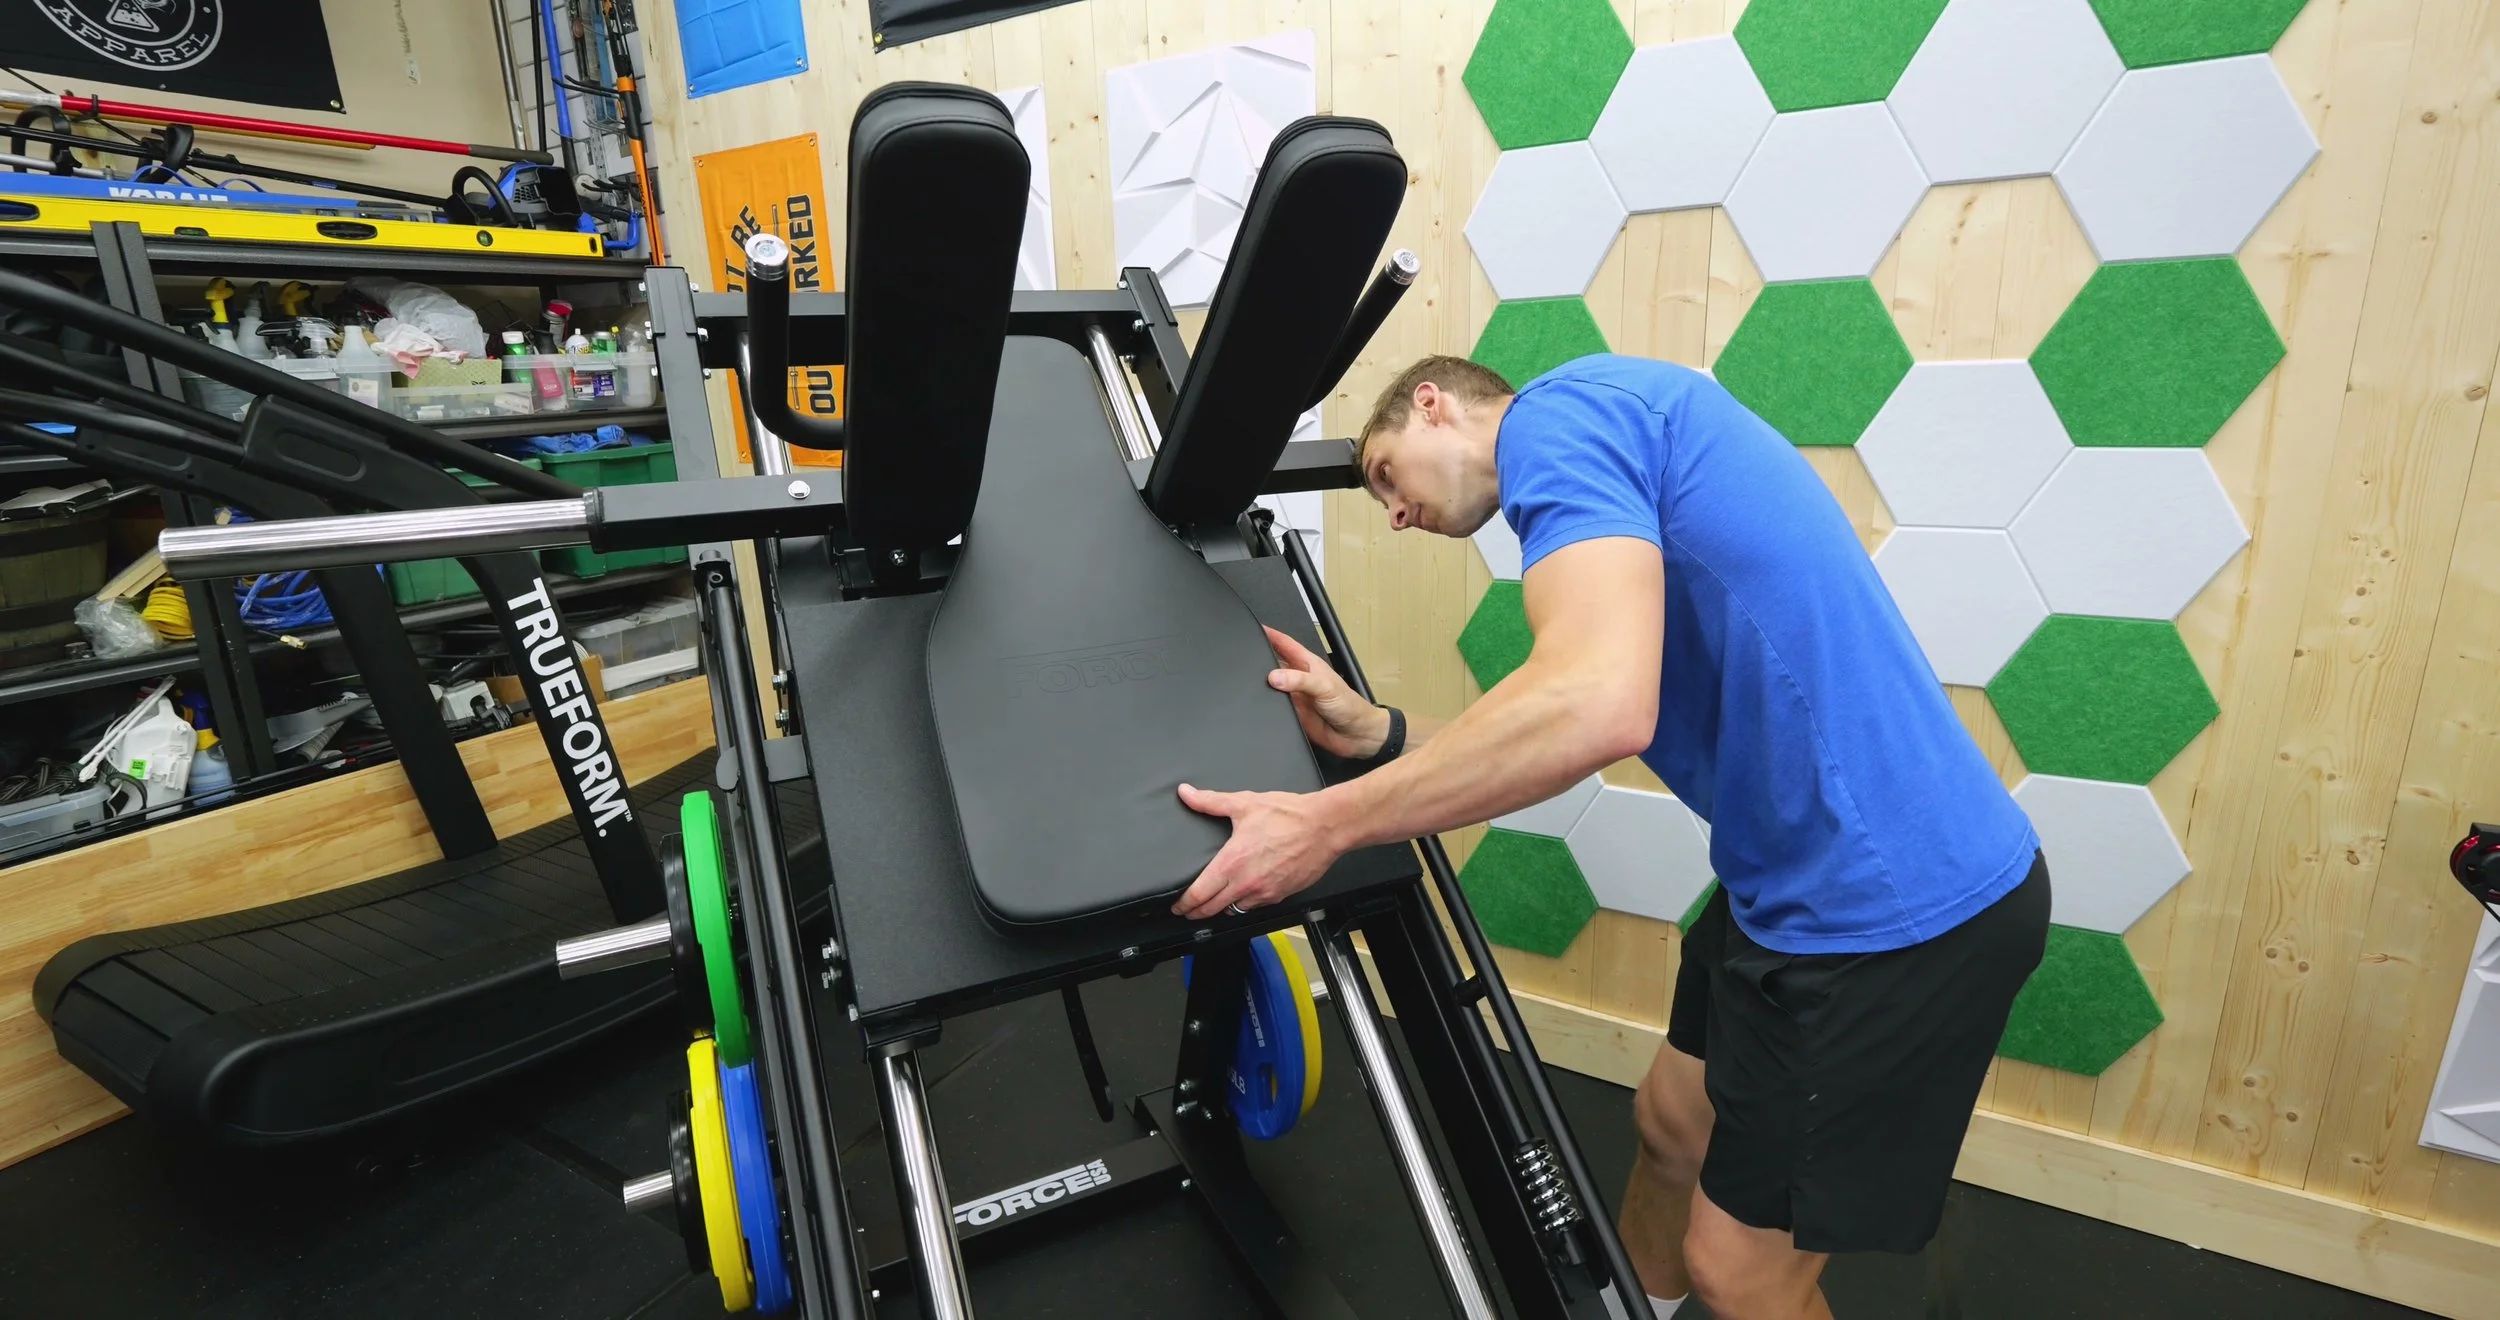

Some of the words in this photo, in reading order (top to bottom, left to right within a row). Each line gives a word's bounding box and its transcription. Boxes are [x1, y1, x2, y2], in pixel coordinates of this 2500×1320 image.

[49, 5, 210, 64] APPAREL
[953, 1164, 1096, 1226] FORCE
[1086, 1158, 1112, 1186] USA
